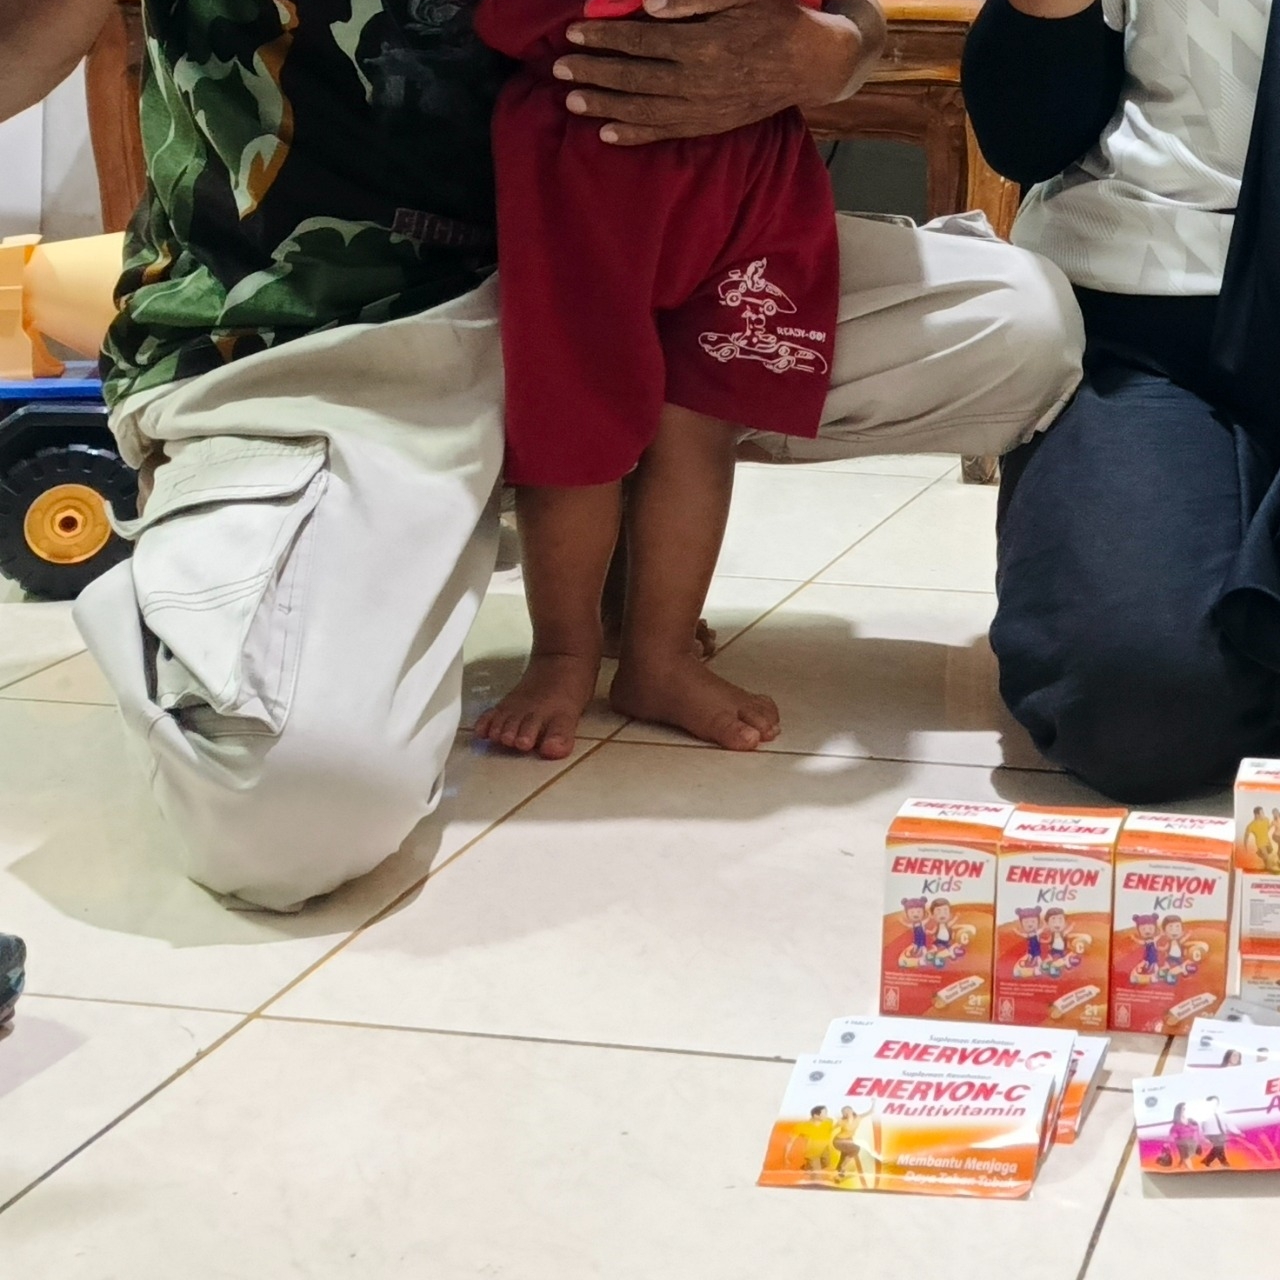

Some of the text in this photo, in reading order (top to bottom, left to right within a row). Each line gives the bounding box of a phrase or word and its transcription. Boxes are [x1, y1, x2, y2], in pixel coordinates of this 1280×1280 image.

[912, 801, 1004, 813] ENERVON
[1016, 823, 1110, 835] ENERVON
[891, 856, 984, 878] ENERVON
[1006, 865, 1100, 887] ENERVON
[922, 876, 963, 894] Kids
[1122, 872, 1217, 895] ENERVON
[1037, 884, 1078, 903] Kids
[1153, 893, 1195, 911] Kids
[969, 994, 982, 1006] 21
[1085, 1004, 1098, 1016] 21
[929, 1035, 970, 1044] Suplemen
[874, 1039, 1052, 1070] ENERVON-C
[902, 1070, 944, 1079] Suplemen
[845, 1076, 1031, 1102] ENERVON-C
[882, 1102, 1026, 1117] Multivitamin
[897, 1154, 1018, 1175] Membantu Menjaga
